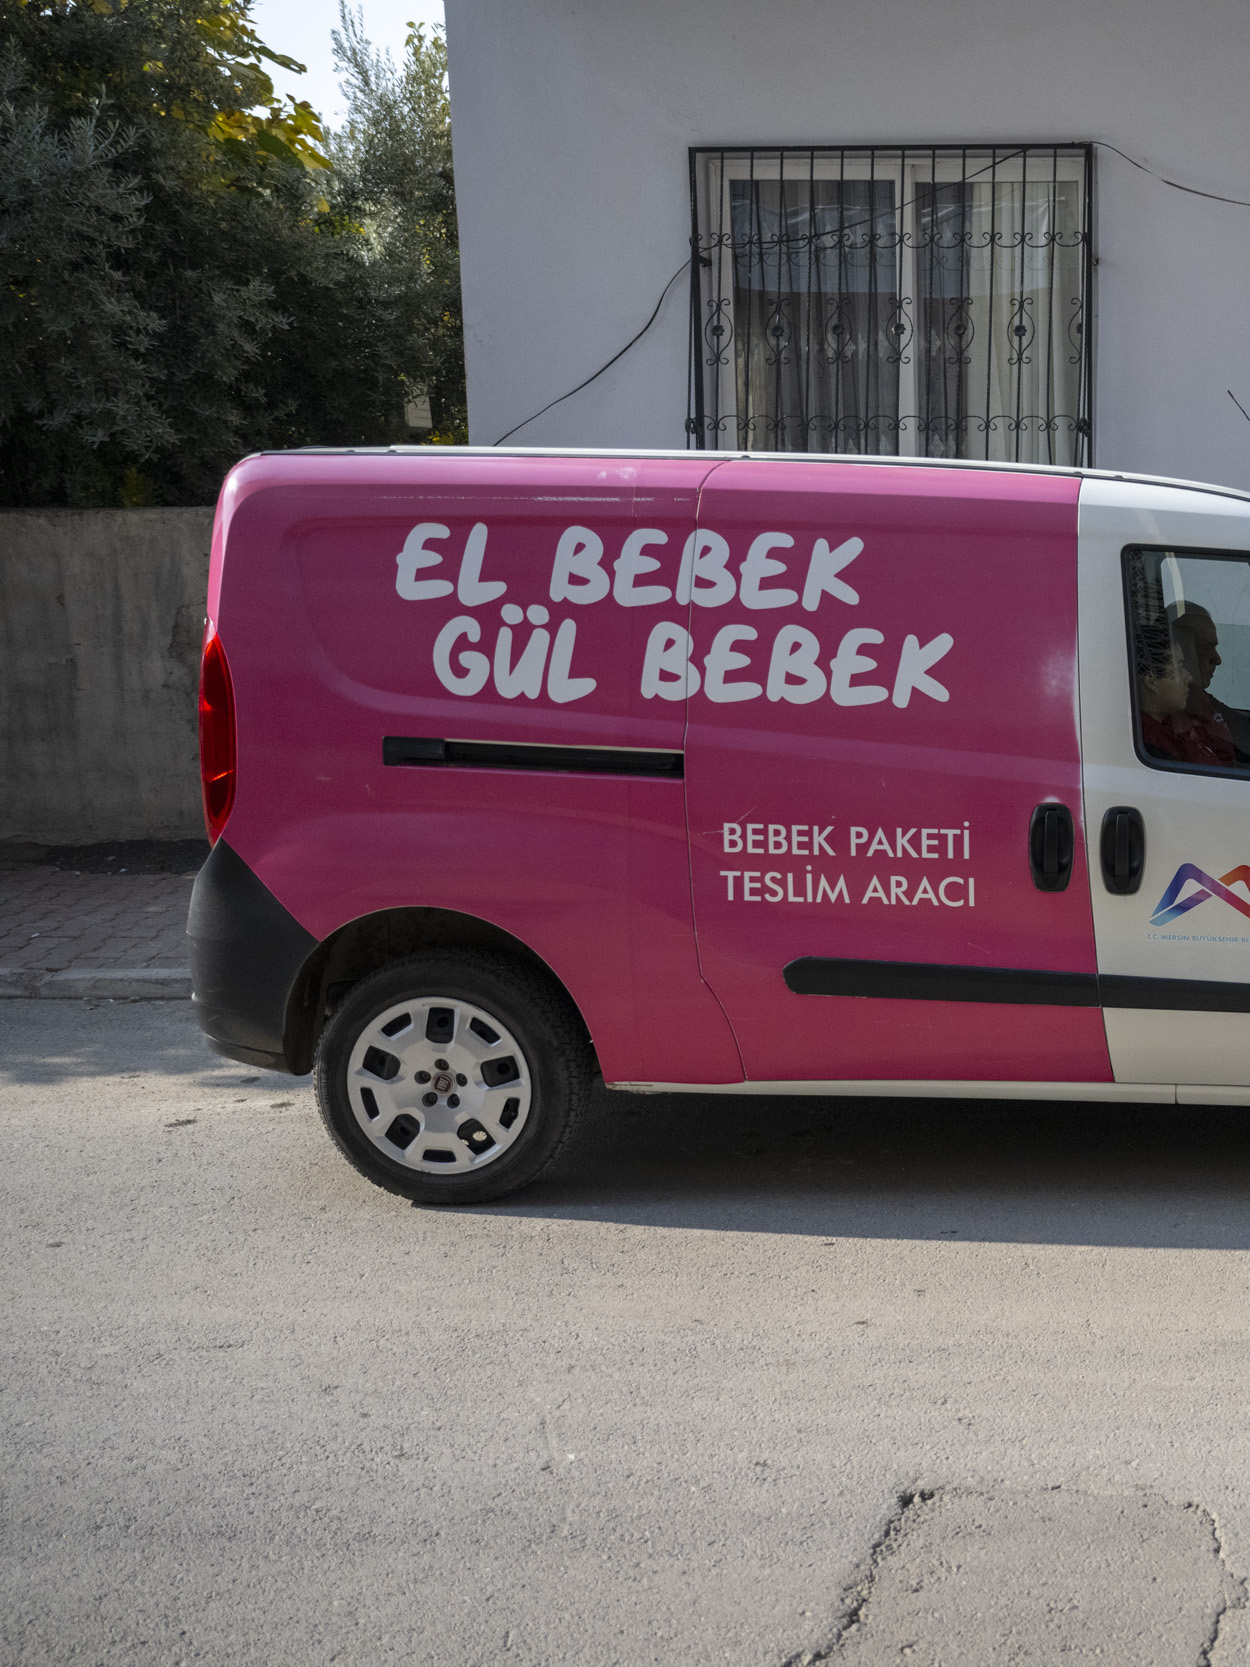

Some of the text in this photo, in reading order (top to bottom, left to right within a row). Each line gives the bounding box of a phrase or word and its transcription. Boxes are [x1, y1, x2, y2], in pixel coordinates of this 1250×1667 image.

[395, 522, 864, 611] EL BEBEK
[433, 603, 954, 708] GÜL BEBEK
[722, 821, 970, 859] BEBEK PAKETİ
[719, 865, 976, 907] TESLİM ARACI
[1191, 935, 1239, 943] BÜYÜKŞEHİR
